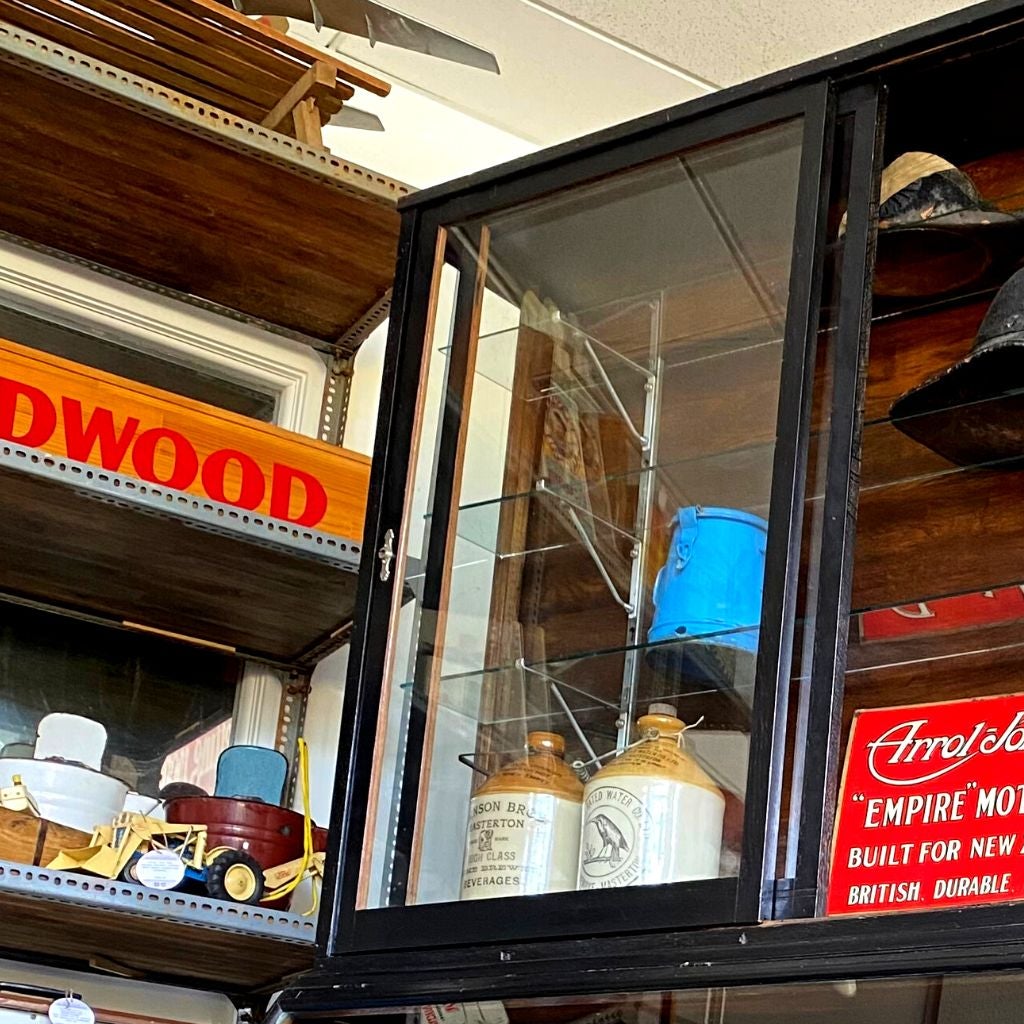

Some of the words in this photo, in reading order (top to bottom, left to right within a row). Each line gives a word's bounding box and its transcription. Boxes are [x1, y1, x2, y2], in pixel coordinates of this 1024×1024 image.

[0, 376, 328, 528] DWOOD
[606, 790, 633, 809] WATER
[487, 851, 516, 861] CLASS
[847, 842, 915, 869] BUILT
[918, 838, 961, 864] FOR
[969, 833, 1017, 859] NEW
